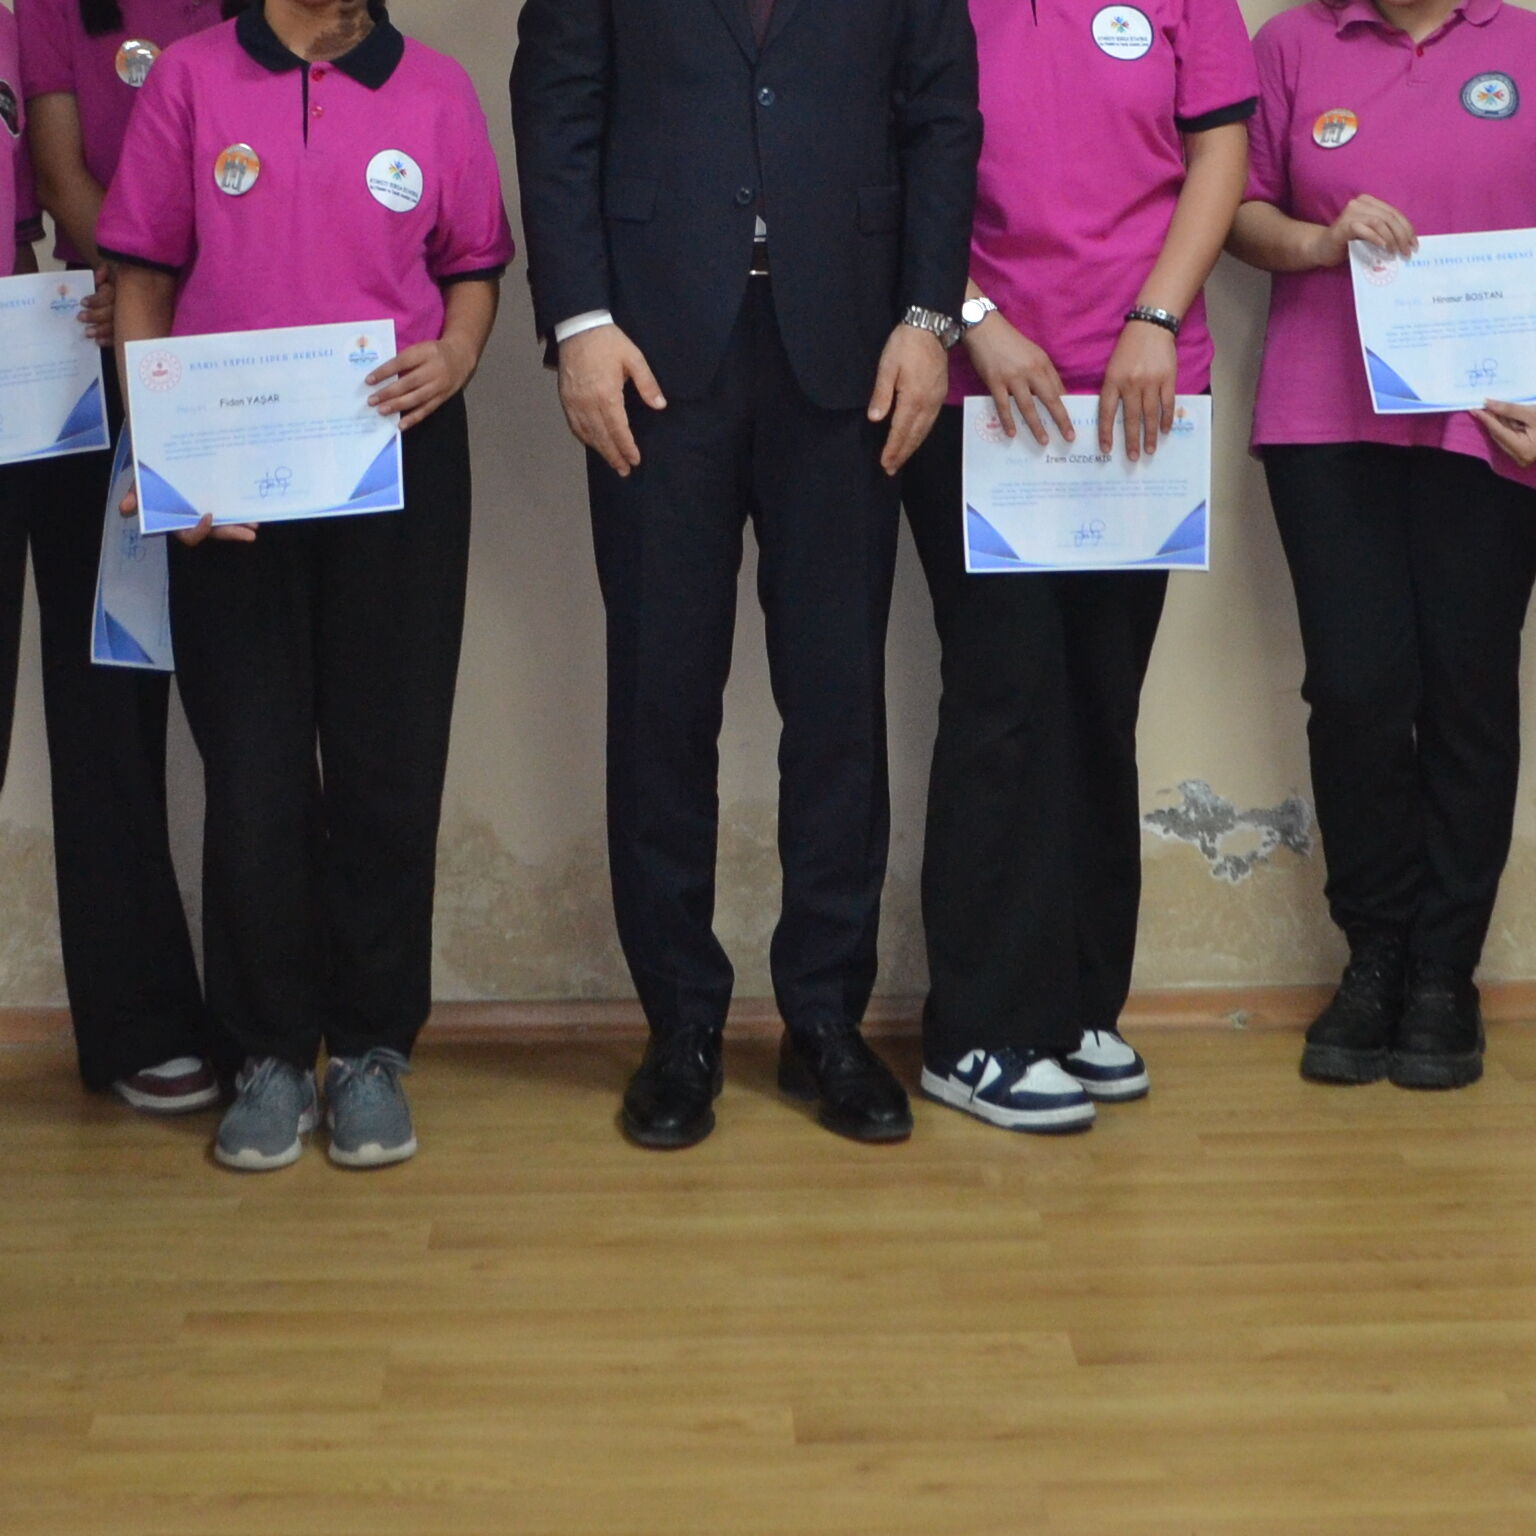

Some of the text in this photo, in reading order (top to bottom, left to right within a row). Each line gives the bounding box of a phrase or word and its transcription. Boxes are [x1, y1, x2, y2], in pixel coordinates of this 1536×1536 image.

[1465, 291, 1504, 302] BOSTAN
[219, 393, 281, 408] Fidan YAŞAR
